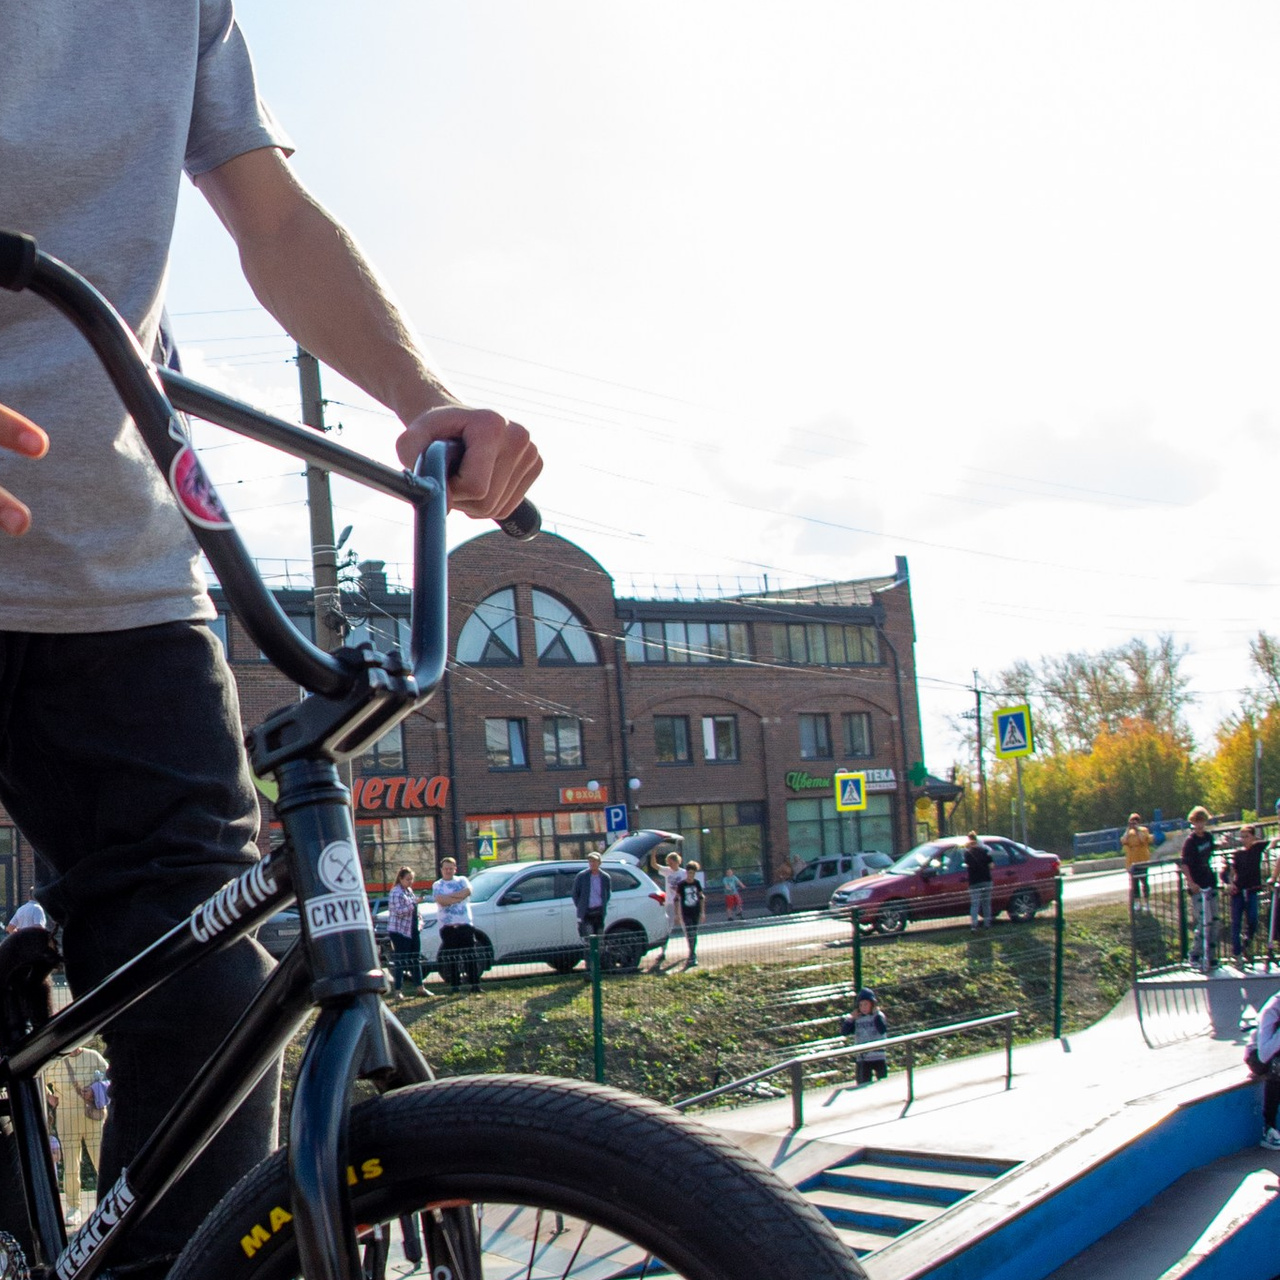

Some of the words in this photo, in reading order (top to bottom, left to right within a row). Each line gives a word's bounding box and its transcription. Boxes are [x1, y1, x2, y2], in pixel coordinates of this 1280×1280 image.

[352, 776, 450, 810] етка
[610, 808, 623, 829] P
[190, 853, 277, 943] CRYPTIC
[312, 899, 368, 927] CRYP
